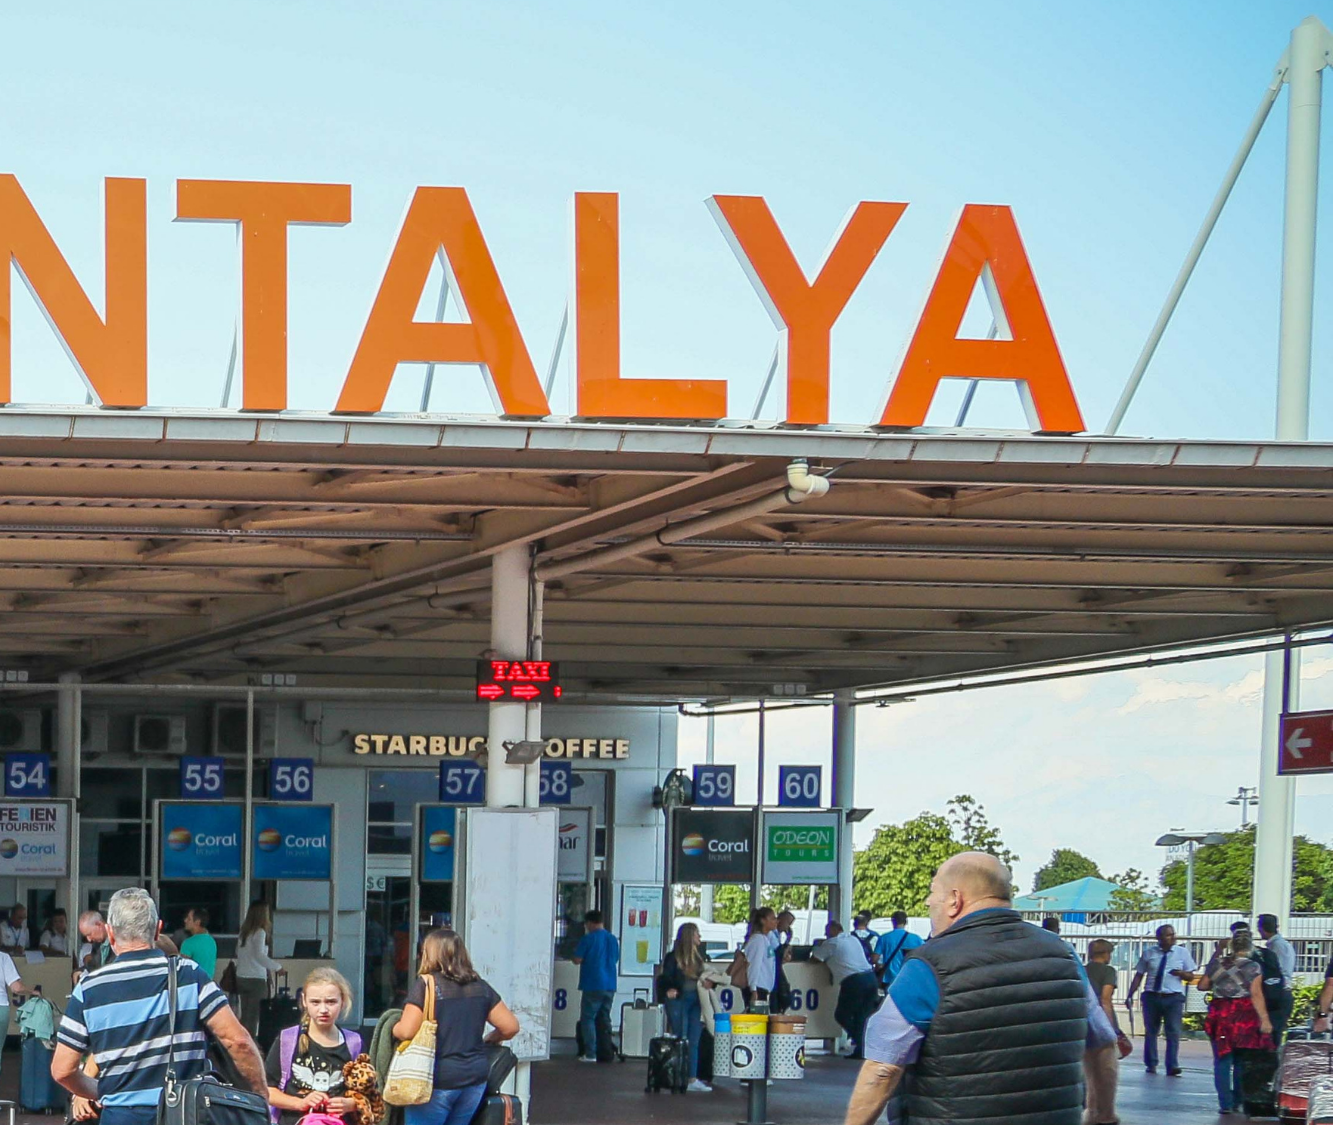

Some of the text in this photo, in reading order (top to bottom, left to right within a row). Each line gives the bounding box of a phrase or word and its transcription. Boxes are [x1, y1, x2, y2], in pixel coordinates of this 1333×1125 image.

[491, 661, 551, 682] TAXI
[354, 734, 630, 759] STARBUC OFFEE
[10, 762, 46, 789] 54
[185, 764, 220, 791] 55
[275, 766, 310, 792] 56
[445, 768, 480, 794] 57
[699, 772, 732, 797] 59
[785, 772, 819, 798] 60
[0, 808, 56, 821] FERIEN
[0, 822, 56, 832] TOURISTIK
[21, 843, 56, 854] Coral
[195, 833, 238, 847] Coral
[285, 834, 327, 848] Coral
[708, 839, 749, 853] Coral
[773, 830, 830, 846] ODEON
[708, 853, 732, 862] travel
[774, 849, 829, 857] TOURS
[554, 989, 567, 1010] 8
[720, 989, 734, 1011] 9
[791, 988, 819, 1011] 60
